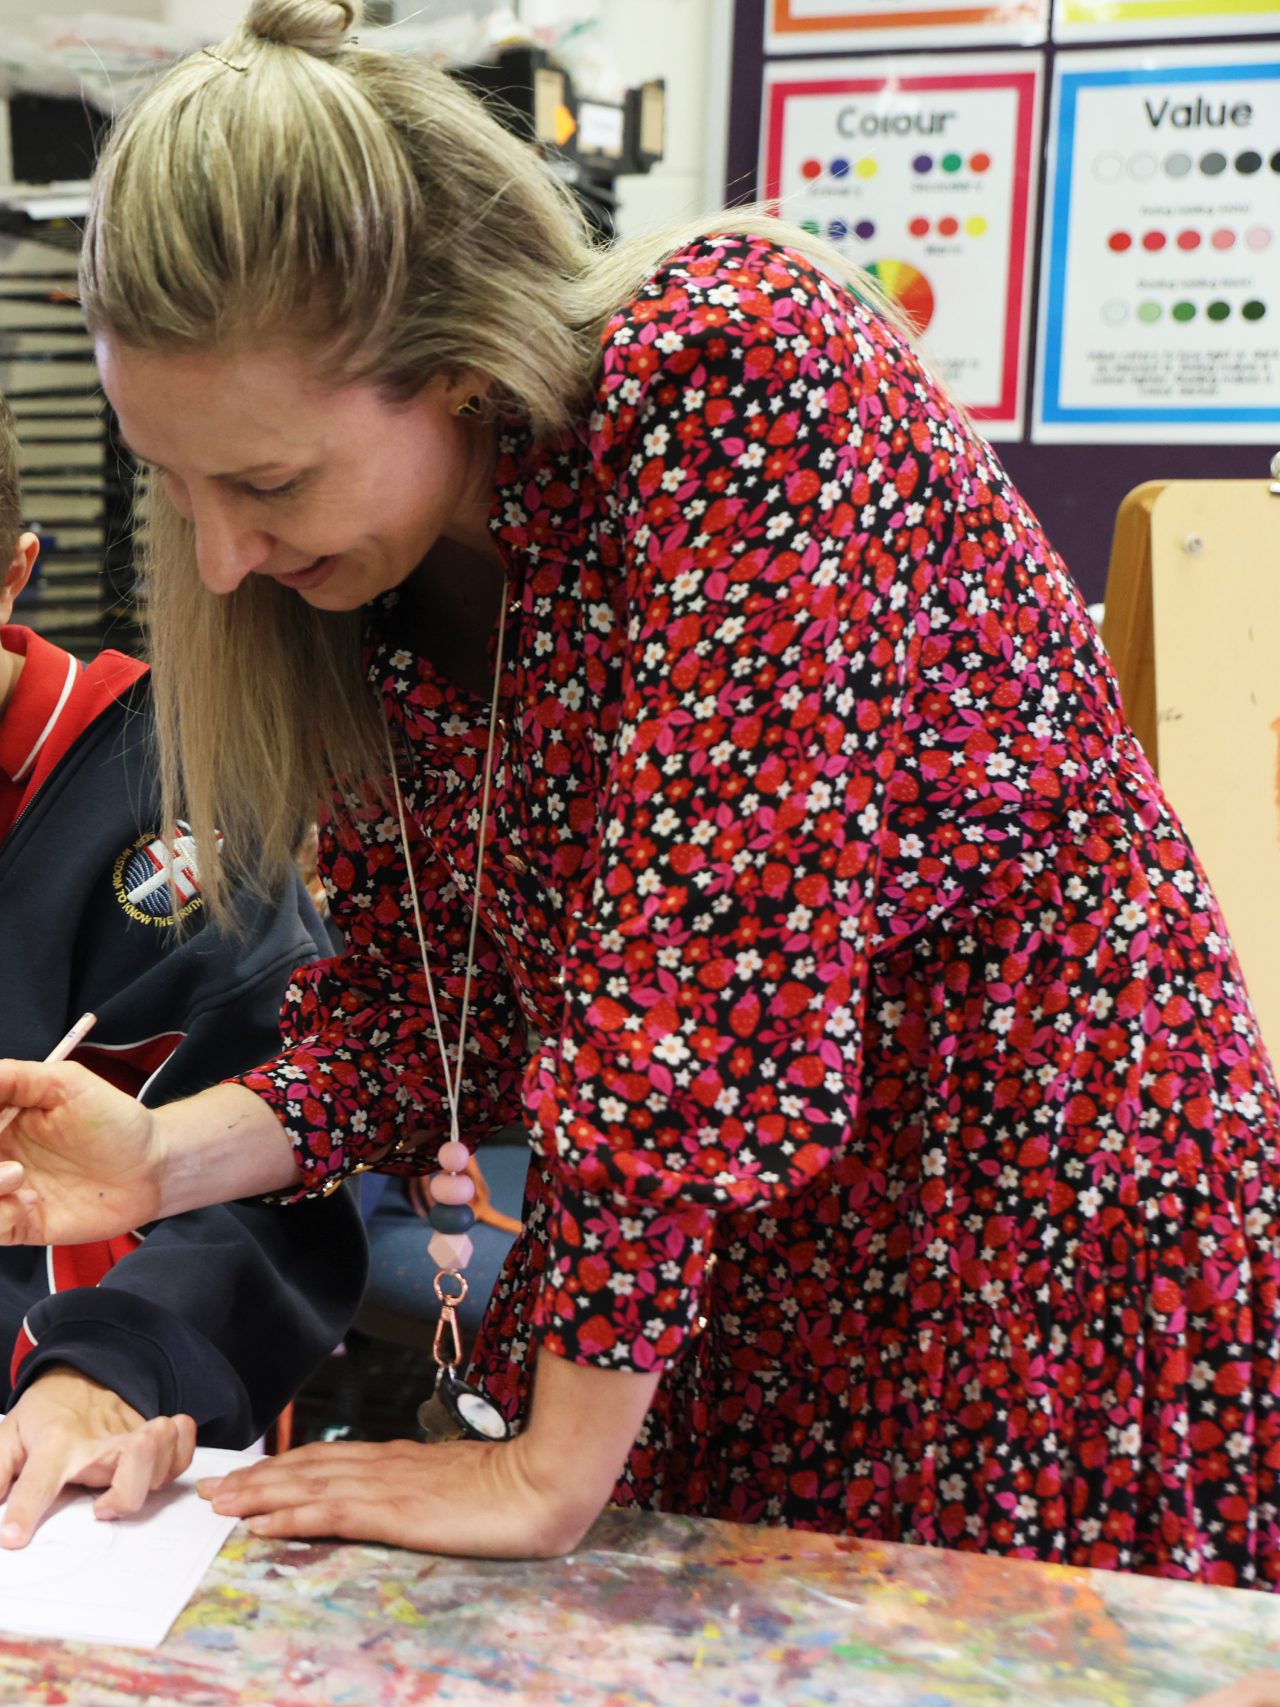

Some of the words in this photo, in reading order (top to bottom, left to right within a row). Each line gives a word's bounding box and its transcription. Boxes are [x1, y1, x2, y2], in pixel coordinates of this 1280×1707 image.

[836, 104, 956, 138] Colour
[1143, 96, 1253, 130] Value
[115, 888, 127, 904] TO
[121, 902, 153, 925] KNOW
[153, 916, 174, 927] THE
[177, 897, 203, 920] RUTH
